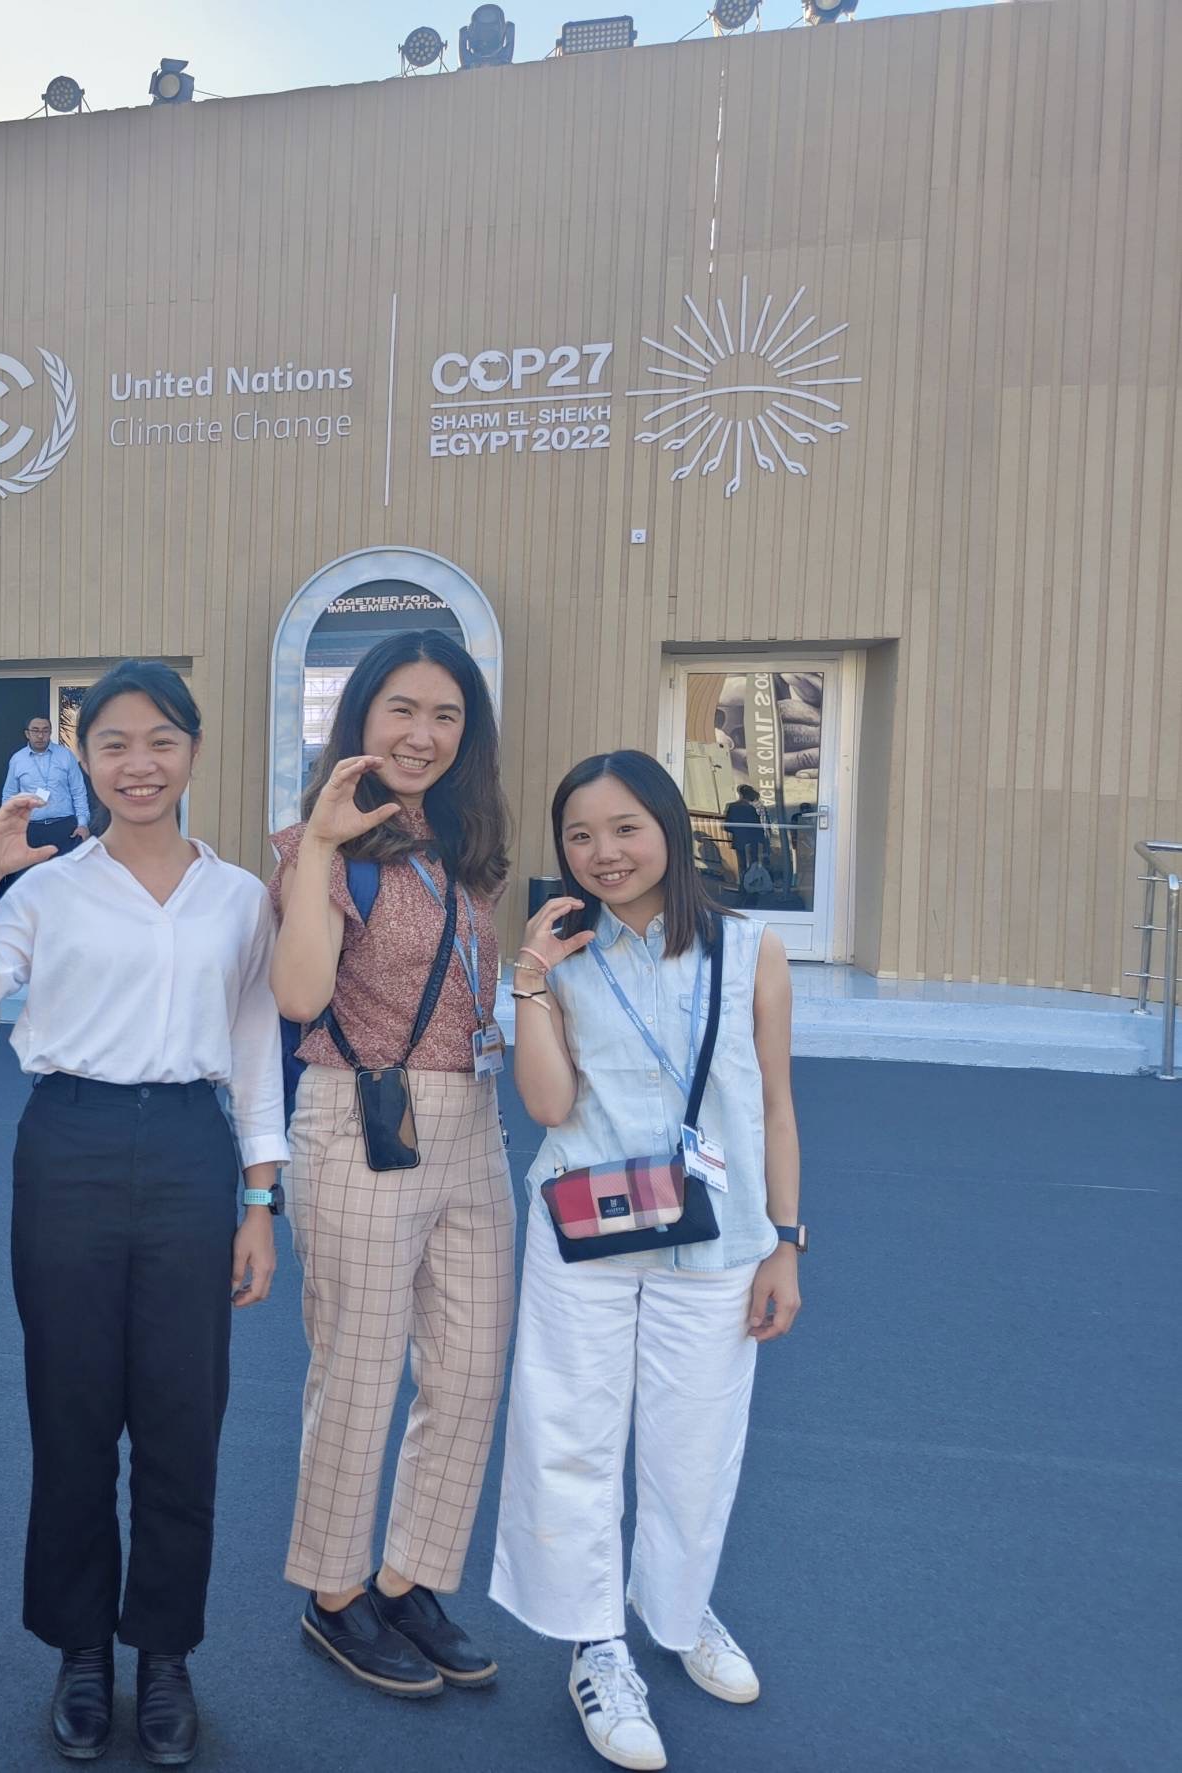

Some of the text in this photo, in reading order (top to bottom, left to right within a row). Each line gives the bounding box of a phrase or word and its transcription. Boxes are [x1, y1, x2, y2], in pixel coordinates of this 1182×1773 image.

[111, 362, 353, 400] United Nations
[432, 343, 612, 394] COP27
[111, 410, 352, 446] Climate Change
[431, 405, 611, 431] SHARM EL-SHEIKH
[403, 594, 430, 603] FOR
